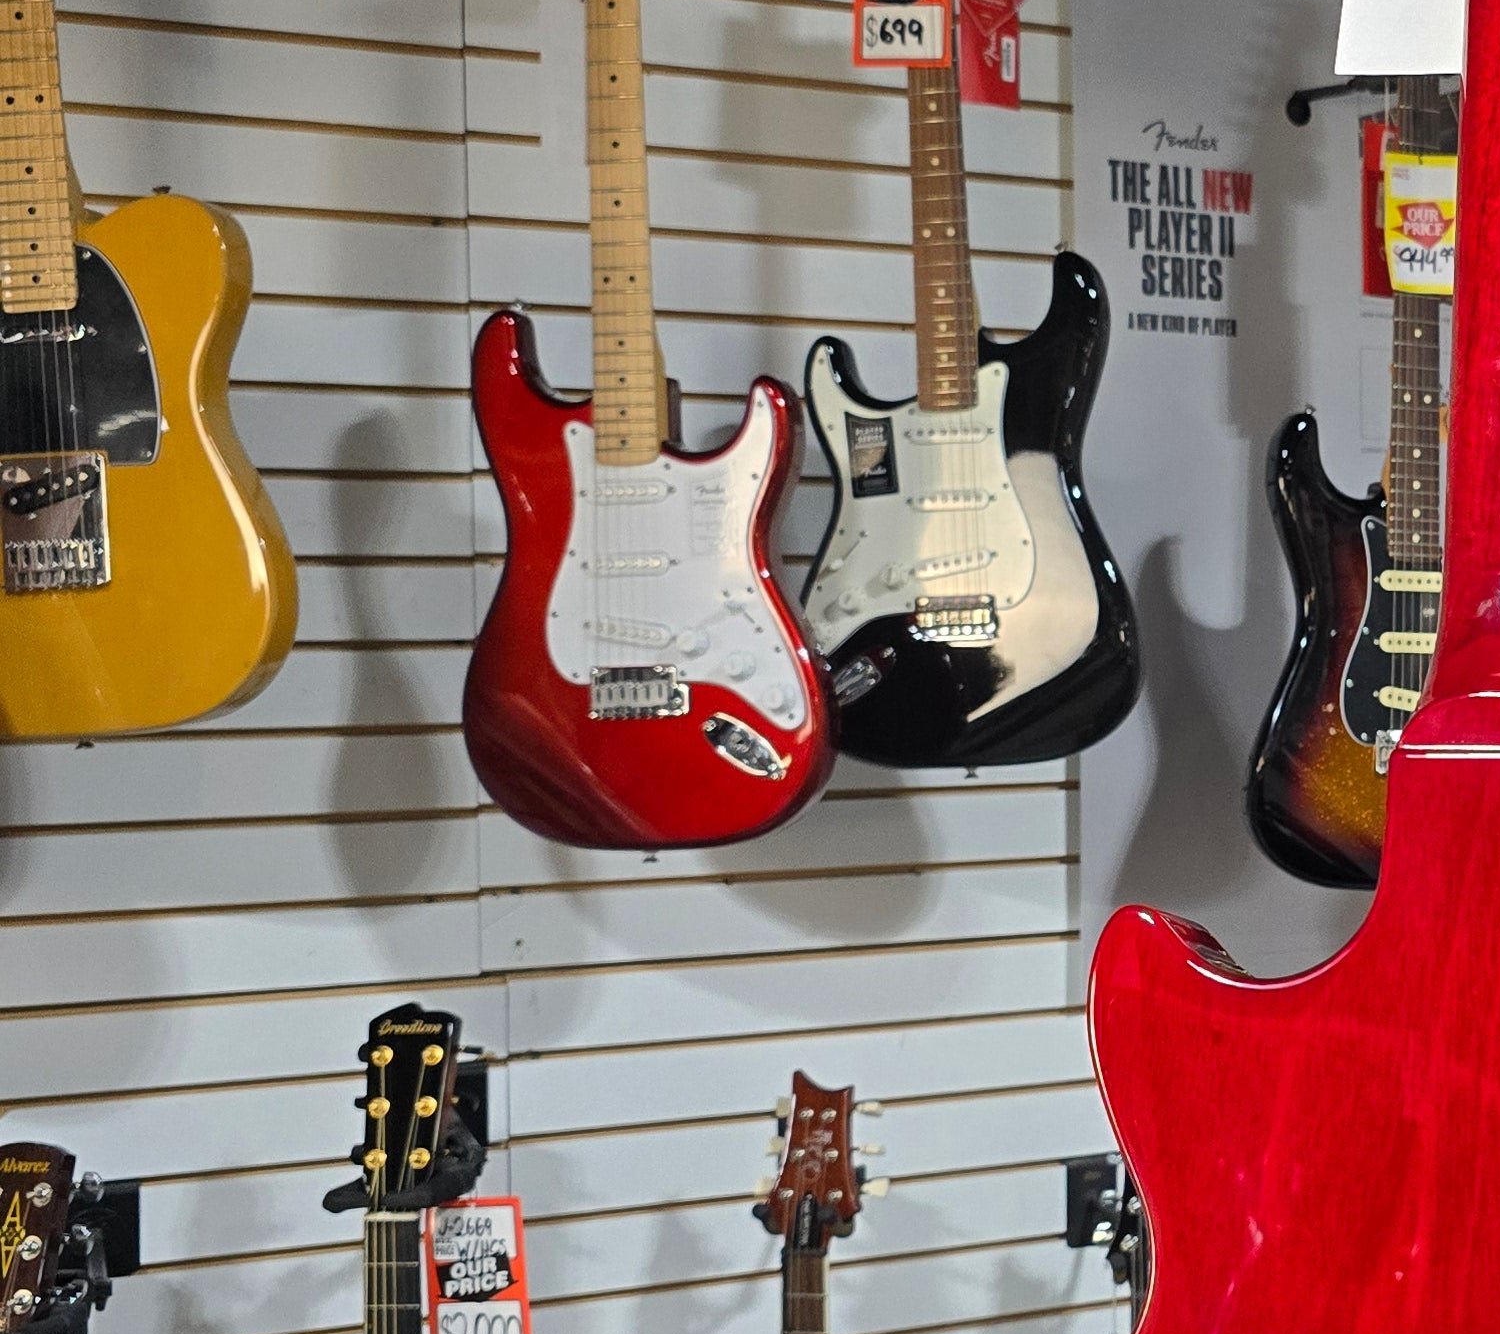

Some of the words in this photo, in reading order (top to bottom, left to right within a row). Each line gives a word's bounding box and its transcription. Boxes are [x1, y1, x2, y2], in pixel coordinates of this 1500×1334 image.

[865, 15, 923, 48] $699
[1141, 120, 1219, 152] Fender
[1107, 157, 1152, 205] THE
[1157, 163, 1197, 209] ALL
[1202, 169, 1254, 216] NEW
[1403, 221, 1444, 236] PRICE
[1406, 207, 1439, 223] OUR
[1127, 207, 1214, 255] PLAYER
[1219, 215, 1235, 258] II
[1141, 253, 1223, 302] SERIES
[1127, 312, 1135, 330] A
[1136, 312, 1159, 332] NEW
[1161, 314, 1185, 334] KIND
[1188, 316, 1199, 335] OF
[1201, 317, 1237, 338] PLAYER
[450, 1256, 497, 1279] OUR
[444, 1270, 510, 1299] PRICE
